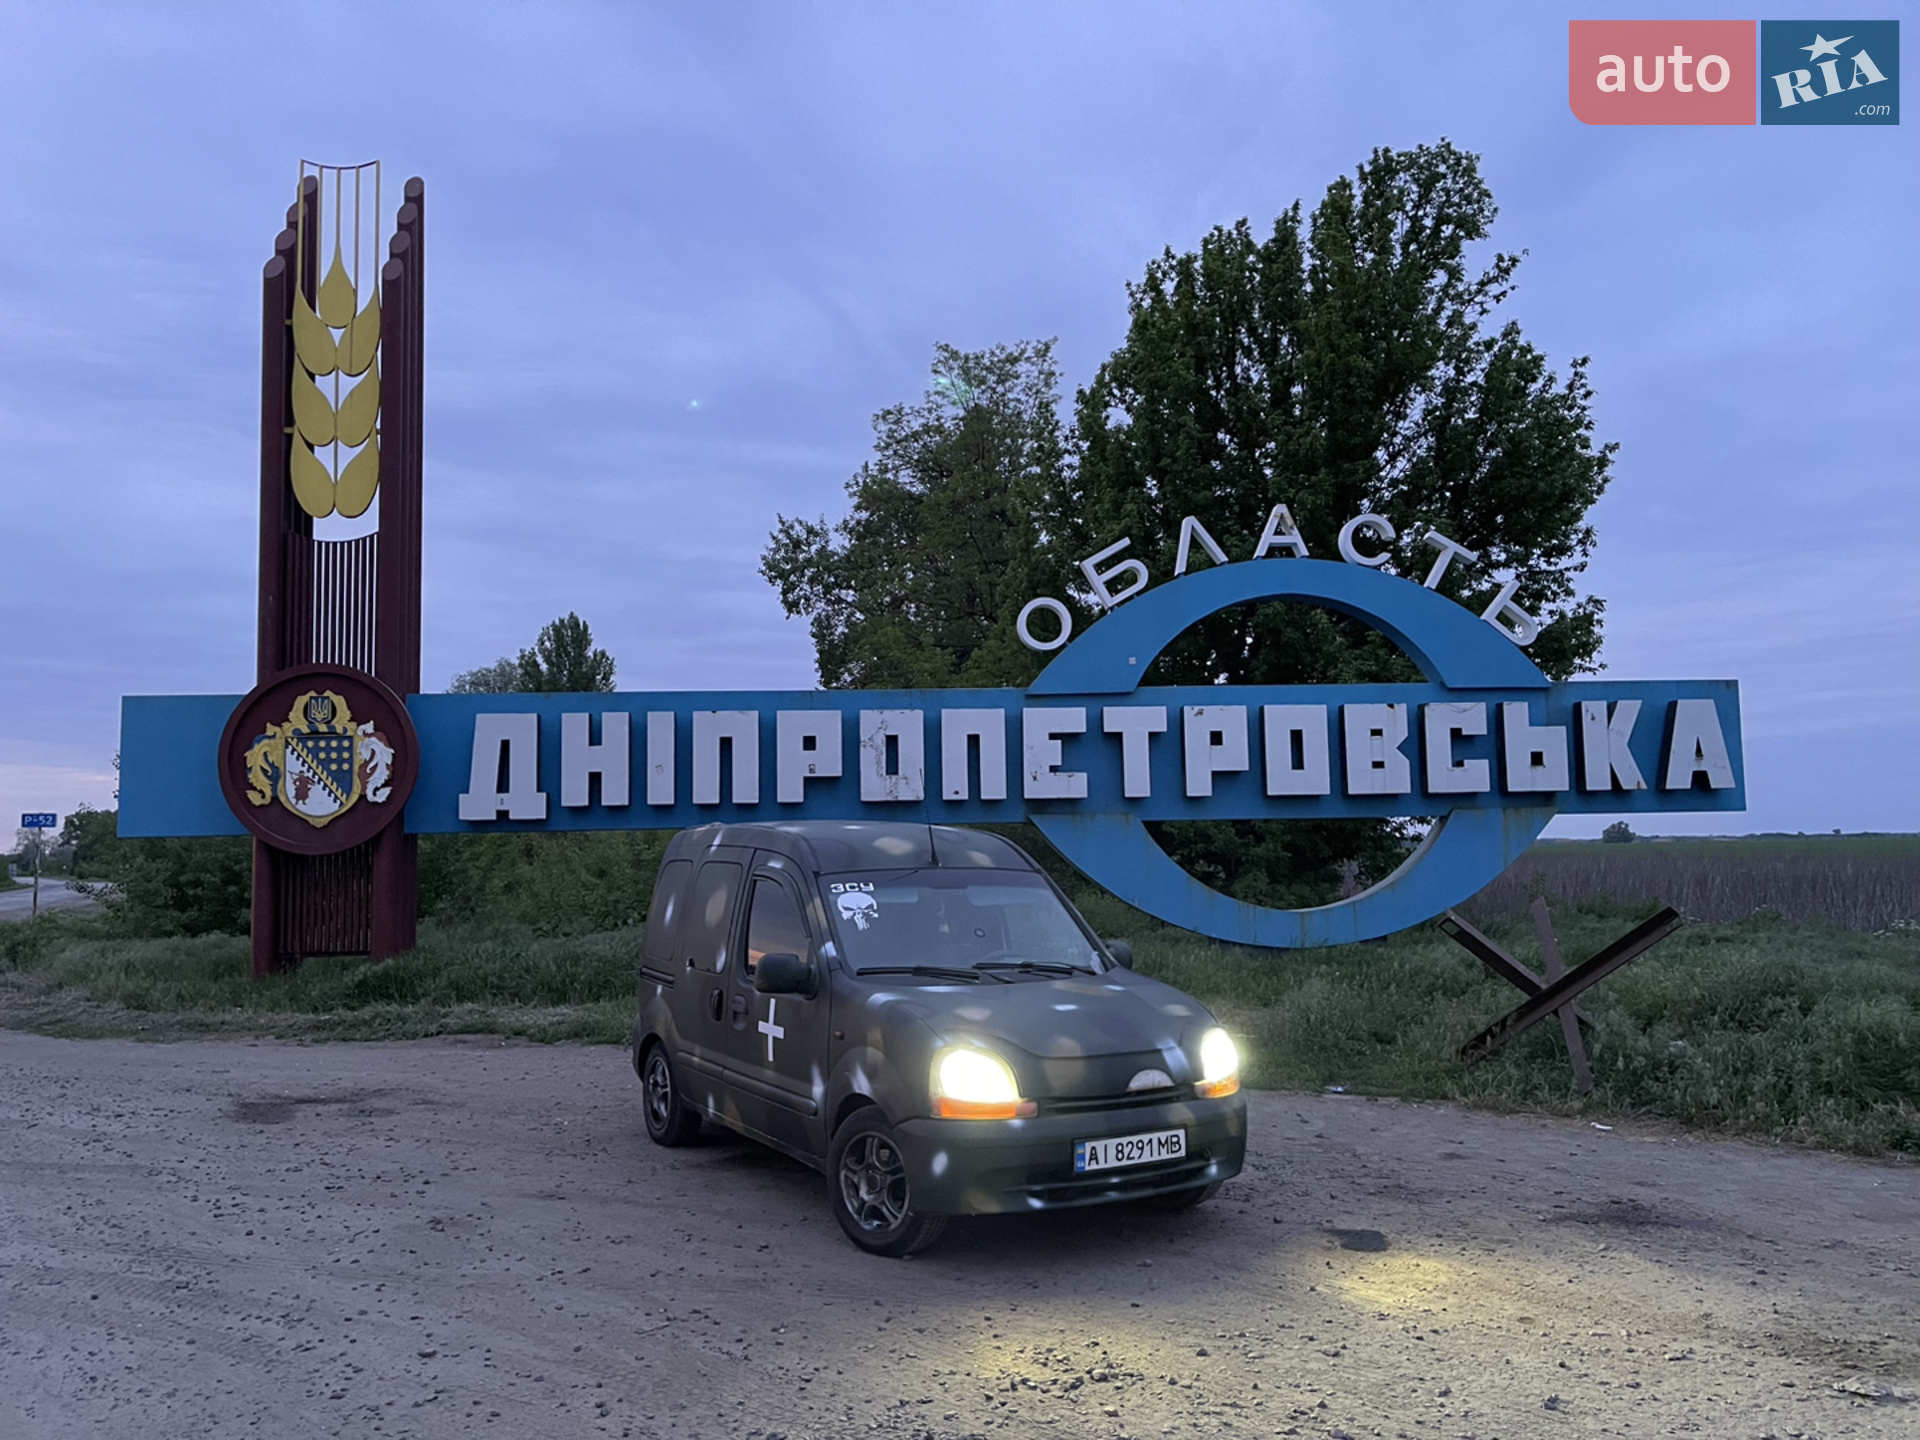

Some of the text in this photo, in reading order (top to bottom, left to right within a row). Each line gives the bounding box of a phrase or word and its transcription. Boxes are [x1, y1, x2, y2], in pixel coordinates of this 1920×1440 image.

[1016, 503, 1540, 651] ОБЛАСТЬ
[458, 698, 1737, 822] ДНІПРОПЕТРОВСЬКА
[1087, 1133, 1182, 1166] AI 8291 MB
